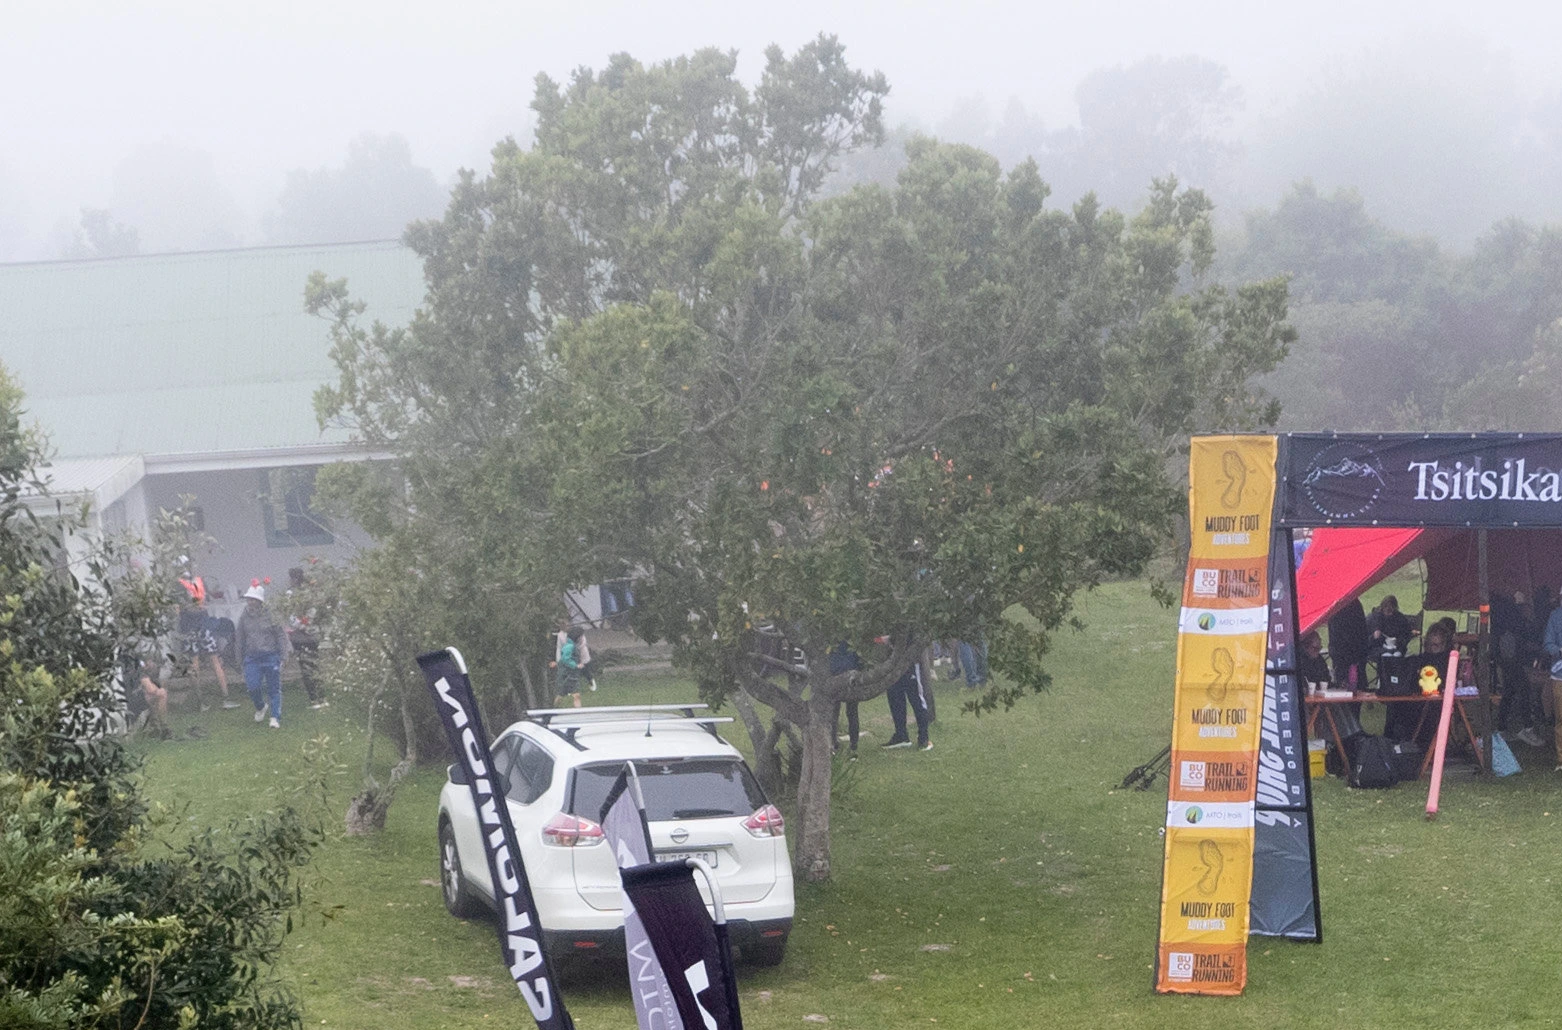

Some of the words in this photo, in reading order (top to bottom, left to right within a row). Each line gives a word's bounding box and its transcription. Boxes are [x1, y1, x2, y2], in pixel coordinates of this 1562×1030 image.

[1205, 515, 1237, 532] MUDDY
[1240, 514, 1260, 532] FOOT
[1219, 569, 1247, 584] TRAIL
[1191, 708, 1223, 725] MUDDY
[1226, 708, 1247, 725] FOOT
[1206, 762, 1235, 777] TRAIL
[1204, 777, 1248, 792] RUNNING
[1180, 902, 1213, 918] MUDDY
[1215, 902, 1235, 918] FOOT
[1194, 954, 1221, 968] TRAIL
[1192, 969, 1235, 983] RUNNING
